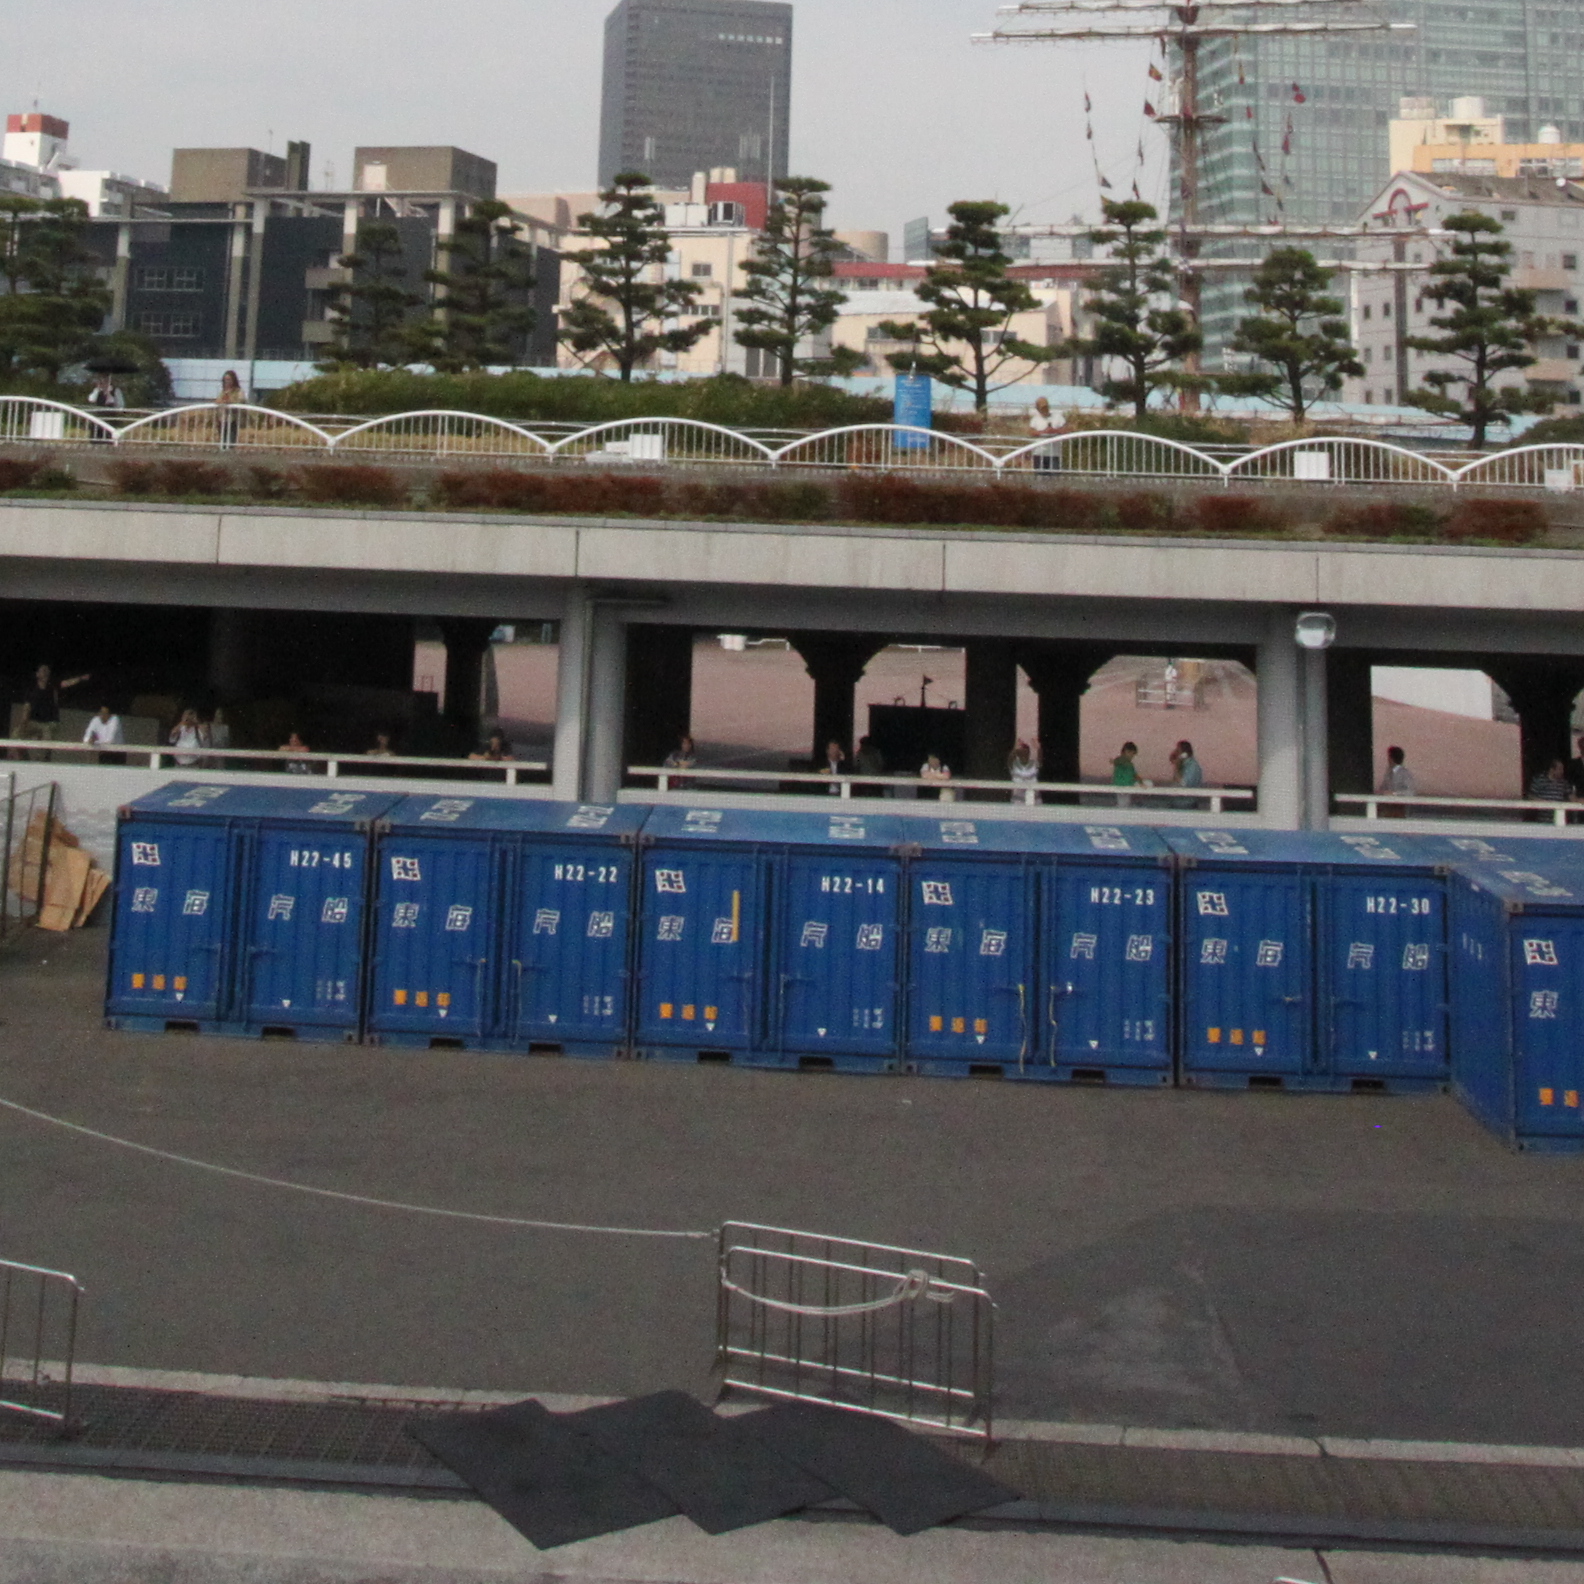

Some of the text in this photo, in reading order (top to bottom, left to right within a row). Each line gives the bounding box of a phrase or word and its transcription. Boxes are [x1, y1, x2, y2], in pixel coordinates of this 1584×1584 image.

[289, 849, 352, 869] H22-45
[554, 864, 618, 883] H22-22
[821, 876, 885, 894] H22-14
[1090, 887, 1155, 906] H22-23
[1366, 896, 1430, 915] H22-30
